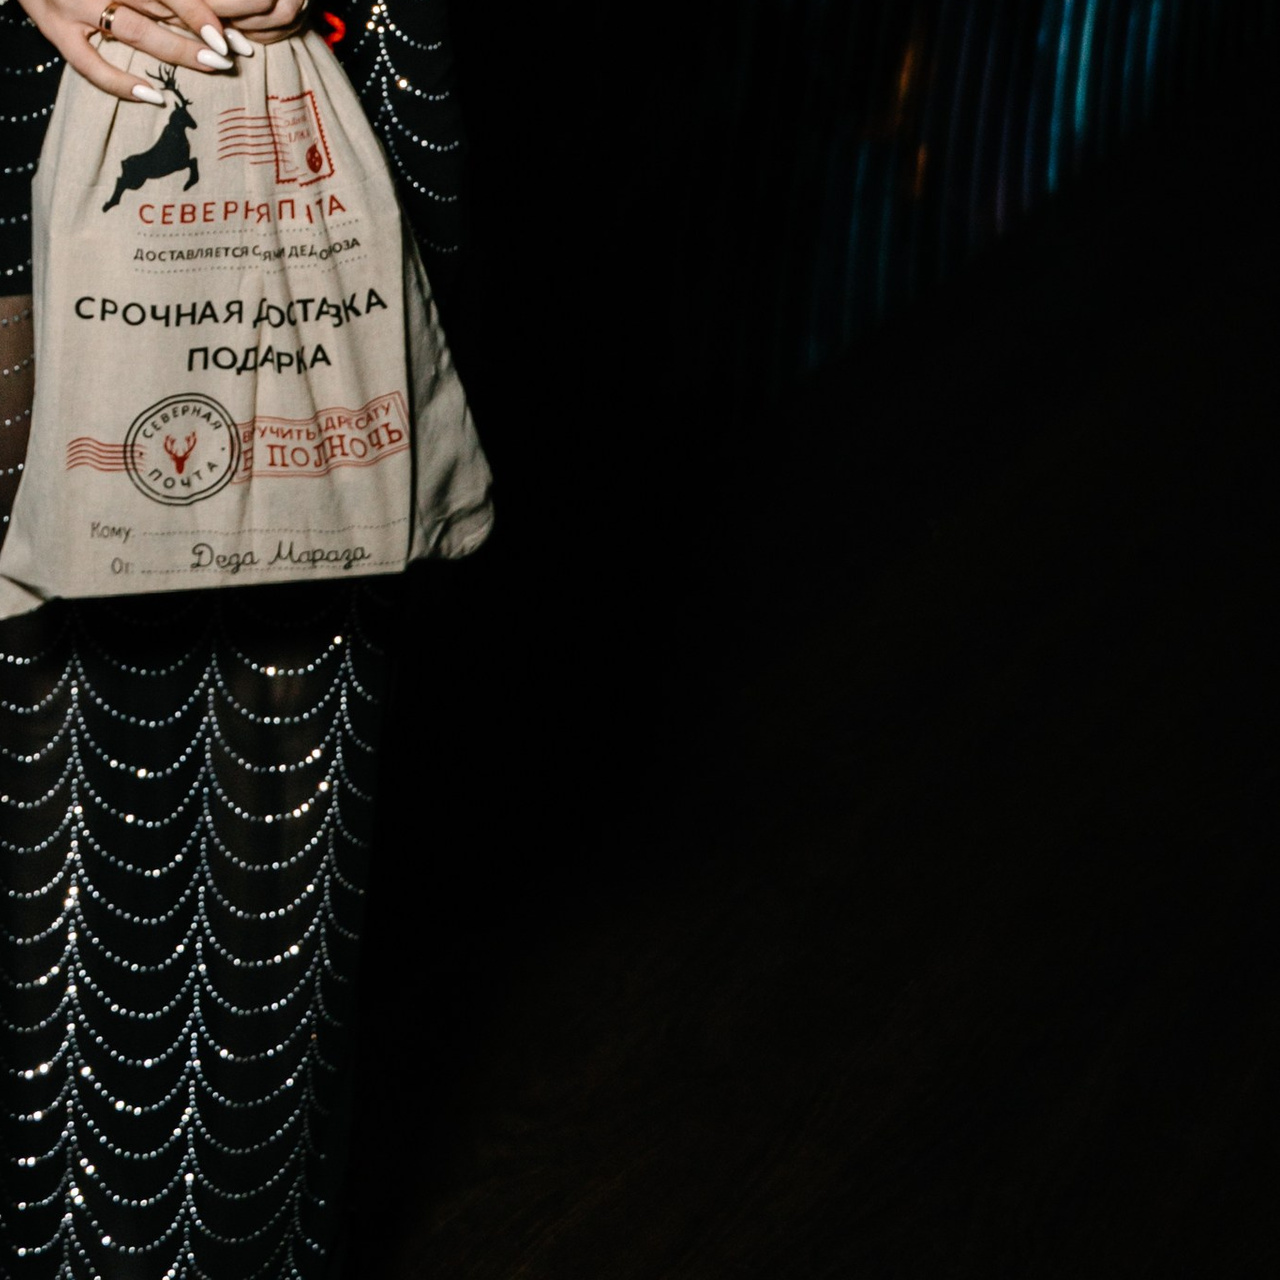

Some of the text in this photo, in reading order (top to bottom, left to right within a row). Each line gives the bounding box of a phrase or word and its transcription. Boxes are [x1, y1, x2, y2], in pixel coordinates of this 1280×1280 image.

[133, 245, 249, 261] ДОСТАВЛЯЕТСЯ
[74, 296, 243, 327] СРОЧНАЯ
[188, 343, 332, 375] ПОДАРКА
[142, 405, 222, 439] СЕВЕРНАЯ
[267, 422, 403, 468] ПОЛНОЧЬ
[148, 461, 219, 489] ПОЧТА
[190, 542, 260, 575] Деда
